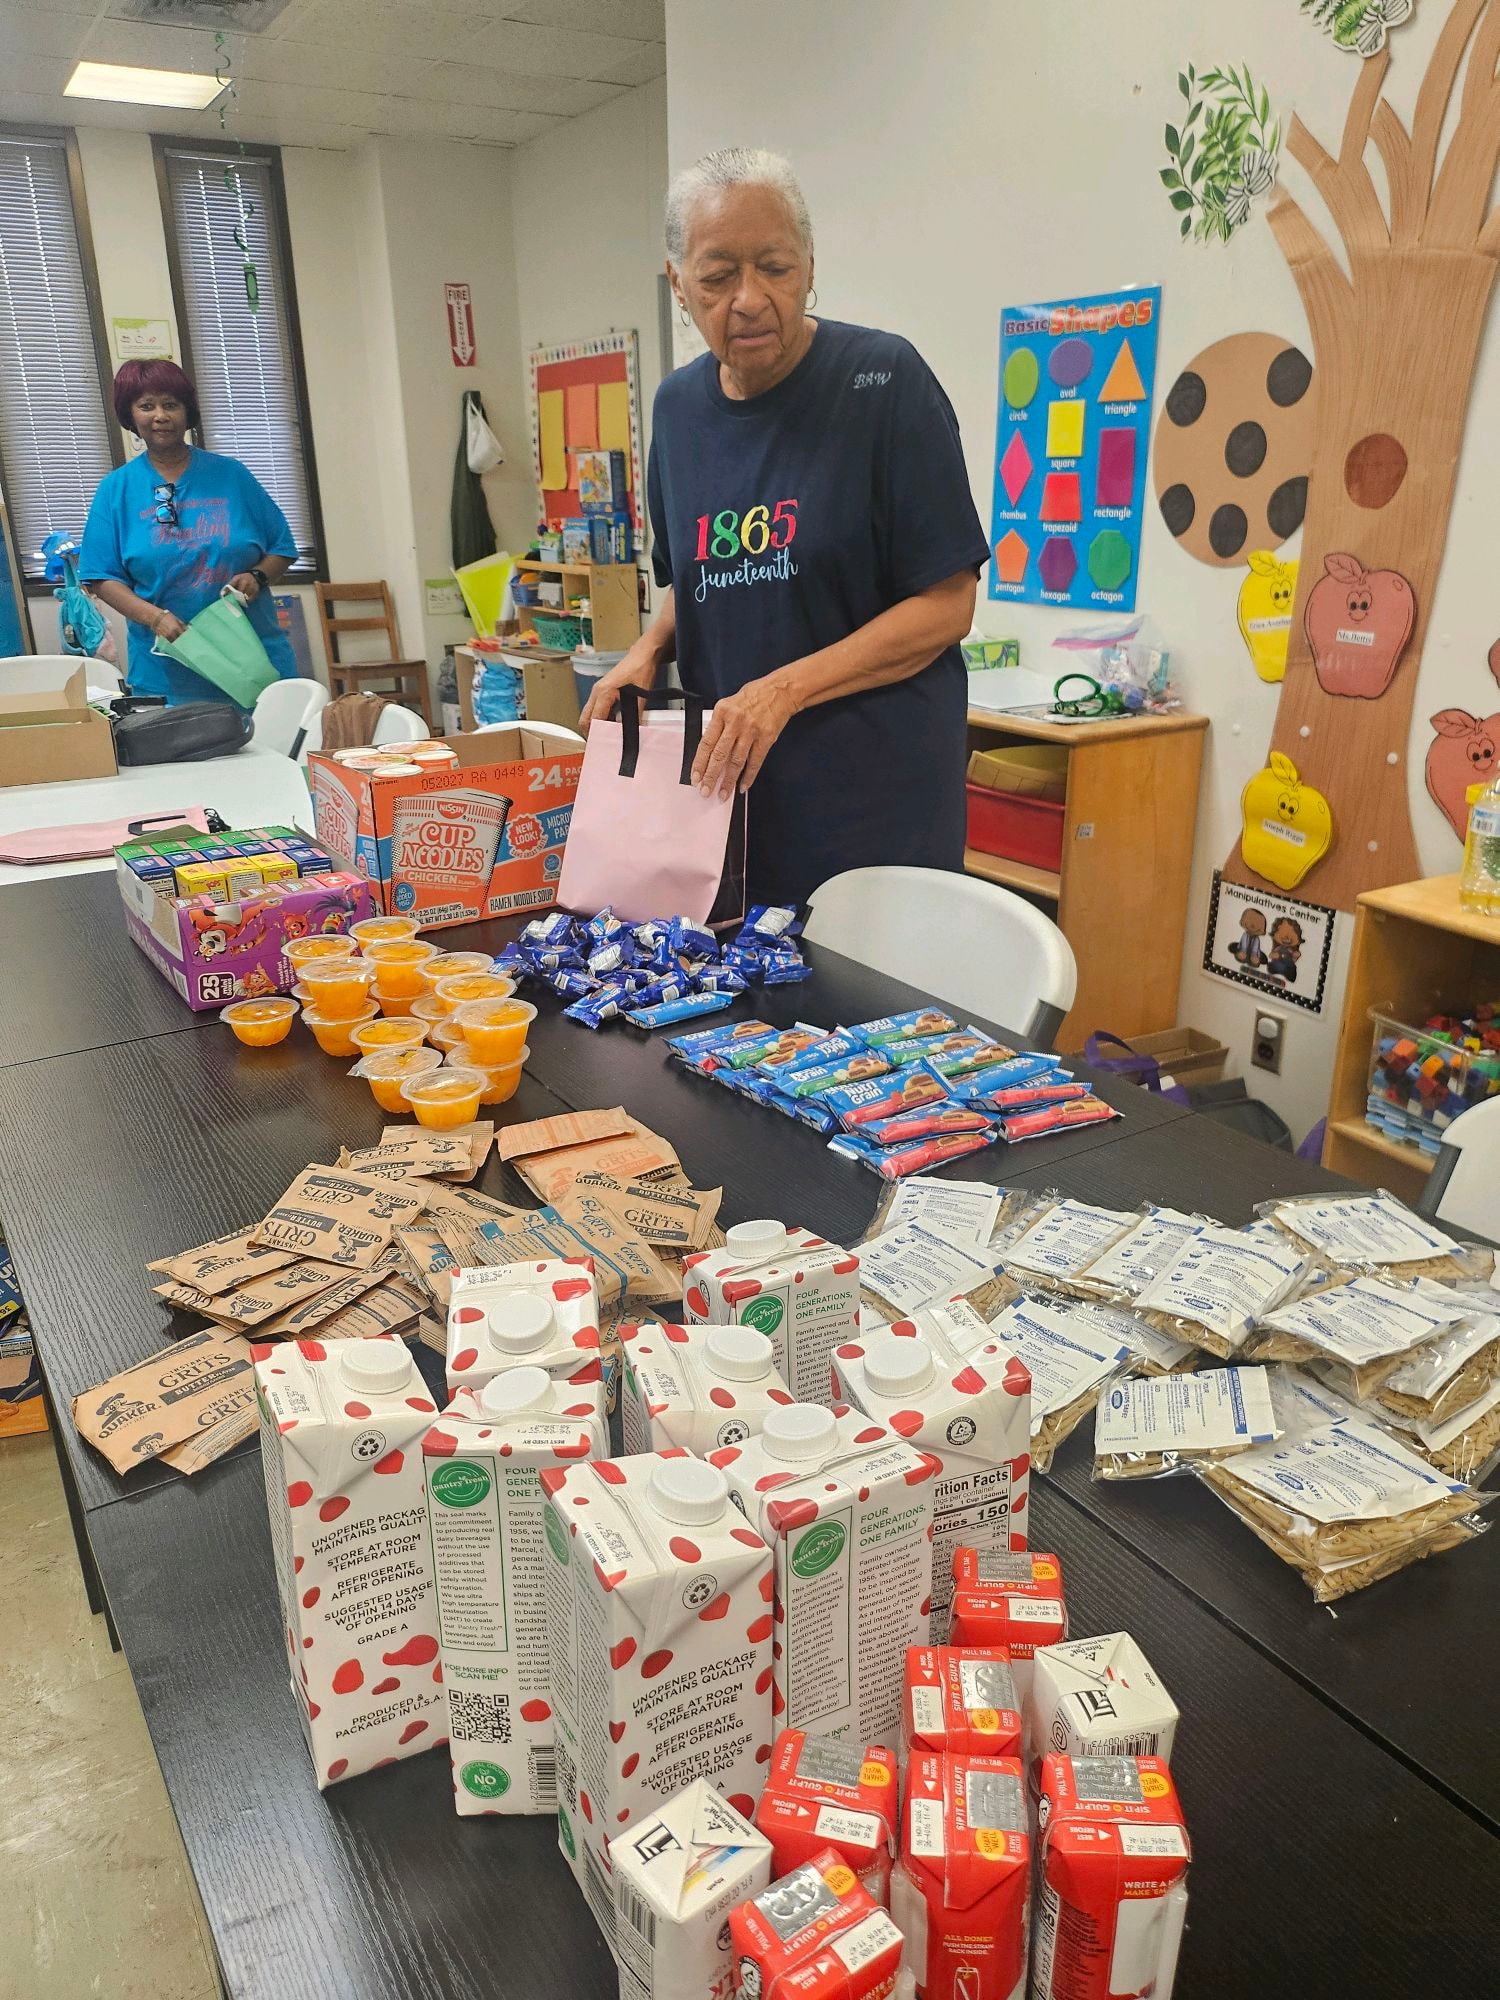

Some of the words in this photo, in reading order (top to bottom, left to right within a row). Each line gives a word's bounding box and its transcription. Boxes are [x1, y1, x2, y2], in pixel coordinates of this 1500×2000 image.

[1005, 319, 1048, 336] Basic
[1048, 298, 1152, 336] Shapes
[1060, 387, 1076, 399] oval
[1009, 412, 1028, 421] circle
[1104, 403, 1136, 415] triangle
[1051, 459, 1075, 469] square
[1000, 510, 1026, 520] rhombus
[1093, 508, 1131, 519] rectangle
[694, 499, 798, 560] 1865
[1043, 522, 1077, 534] trapezoid
[695, 547, 798, 602] Juneteenth
[996, 583, 1025, 594] pentagon
[1040, 589, 1071, 601] hexagon
[1091, 591, 1123, 602] octagon
[422, 774, 464, 790] 052027
[471, 771, 487, 783] RA
[527, 764, 563, 792] 24
[438, 803, 465, 814] NISSIN
[420, 822, 476, 846] CUP
[515, 821, 533, 834] NEW
[515, 830, 539, 845] LOOK!
[400, 842, 484, 873] NOODLES
[408, 871, 457, 885] CHICKEN
[490, 896, 513, 911] RAMEN
[514, 892, 536, 907] NOODLE
[537, 889, 553, 903] SOUP
[1225, 886, 1286, 913] Manipulatives
[1290, 906, 1320, 924] Center
[419, 909, 429, 917] 2.25
[434, 915, 441, 923] WT
[203, 975, 219, 999] 25
[850, 1088, 883, 1105] Grain
[575, 1178, 622, 1190] QUAKER
[300, 1186, 354, 1204] GRITS
[376, 1190, 418, 1207] QUAKER
[289, 1215, 323, 1230] BUTTER
[624, 1209, 684, 1230] GRITS
[264, 1221, 317, 1247] GRITS
[339, 1222, 383, 1243] QUAKER
[268, 1238, 297, 1249] INSTANT
[195, 1256, 246, 1278] QUAKER
[1210, 1263, 1246, 1279] MICROWAVE
[238, 1292, 273, 1310] QUAKER
[795, 1291, 853, 1310] GENERATIONS,
[796, 1289, 819, 1300] FOUR
[1194, 1294, 1210, 1303] KIDS
[796, 1310, 814, 1320] ONE
[816, 1302, 846, 1315] FAMILY
[1027, 1342, 1043, 1352] POUR
[158, 1353, 231, 1388] GRITS
[170, 1356, 206, 1374] INSTANT
[175, 1372, 216, 1395] BUTTER
[98, 1403, 159, 1439] QUAKER
[1343, 1450, 1361, 1460] POUR
[505, 1467, 537, 1475] FOUR
[1327, 1455, 1365, 1475] MICROWAVE
[432, 1480, 462, 1492] pantry
[464, 1475, 490, 1485] fresh
[973, 1470, 1008, 1488] Facts
[507, 1489, 531, 1497] ONE
[860, 1507, 889, 1524] FOUR
[860, 1504, 926, 1535] GENERATIONS,
[977, 1503, 1009, 1520] 150
[311, 1517, 375, 1549] UNOPENED
[378, 1507, 426, 1524] PACKAG
[859, 1533, 881, 1548] ONE
[883, 1518, 919, 1542] FAMILY
[314, 1526, 377, 1556] MAINTAINS
[327, 1548, 364, 1567] STORE
[368, 1543, 382, 1553] AT
[385, 1533, 421, 1548] ROOM
[333, 1543, 417, 1573] TEMPERATURE
[337, 1560, 416, 1590] REFRIGERATE
[331, 1583, 368, 1602] AFTER
[371, 1567, 424, 1587] OPENING
[324, 1592, 392, 1622] SUGGESTED
[395, 1580, 434, 1597] USAGE
[335, 1606, 379, 1626] WITHIN
[382, 1602, 393, 1611] 14
[395, 1592, 425, 1607] DAYS
[345, 1621, 362, 1632] OF
[365, 1603, 417, 1626] OPENING
[357, 1628, 397, 1645] GRADE
[400, 1623, 409, 1631] A
[444, 1663, 461, 1672] FOR
[454, 1671, 480, 1680] SCAN
[482, 1673, 498, 1681] ME!
[632, 1671, 697, 1709] UNOPENED
[700, 1650, 757, 1675] PACKAGE
[634, 1680, 698, 1718] MAINTAINS
[701, 1660, 755, 1684] QUALITY
[352, 1697, 414, 1725] PRODUCED
[416, 1693, 424, 1701] &
[646, 1703, 684, 1729] STORE
[688, 1697, 702, 1709] AT
[706, 1682, 743, 1702] ROOM
[651, 1694, 738, 1735] TEMPERATURE
[335, 1713, 397, 1739] PACKAGED
[399, 1707, 410, 1717] IN
[413, 1693, 444, 1711] U.S.A.
[655, 1712, 737, 1752] REFRIGERATE
[648, 1741, 686, 1766] AFTER
[689, 1719, 744, 1745] OPENING
[640, 1750, 710, 1788] SUGGESTED
[714, 1733, 753, 1754] USAGE
[651, 1766, 694, 1791] WITHIN
[698, 1758, 710, 1769] 14
[714, 1746, 744, 1764] DAYS
[474, 1775, 496, 1785] NO
[660, 1783, 677, 1795] OF
[680, 1759, 734, 1786] OPENING
[1056, 1767, 1064, 1782] TAB
[1144, 1784, 1164, 1792] SHAKE
[772, 1799, 796, 1809] BEFORE
